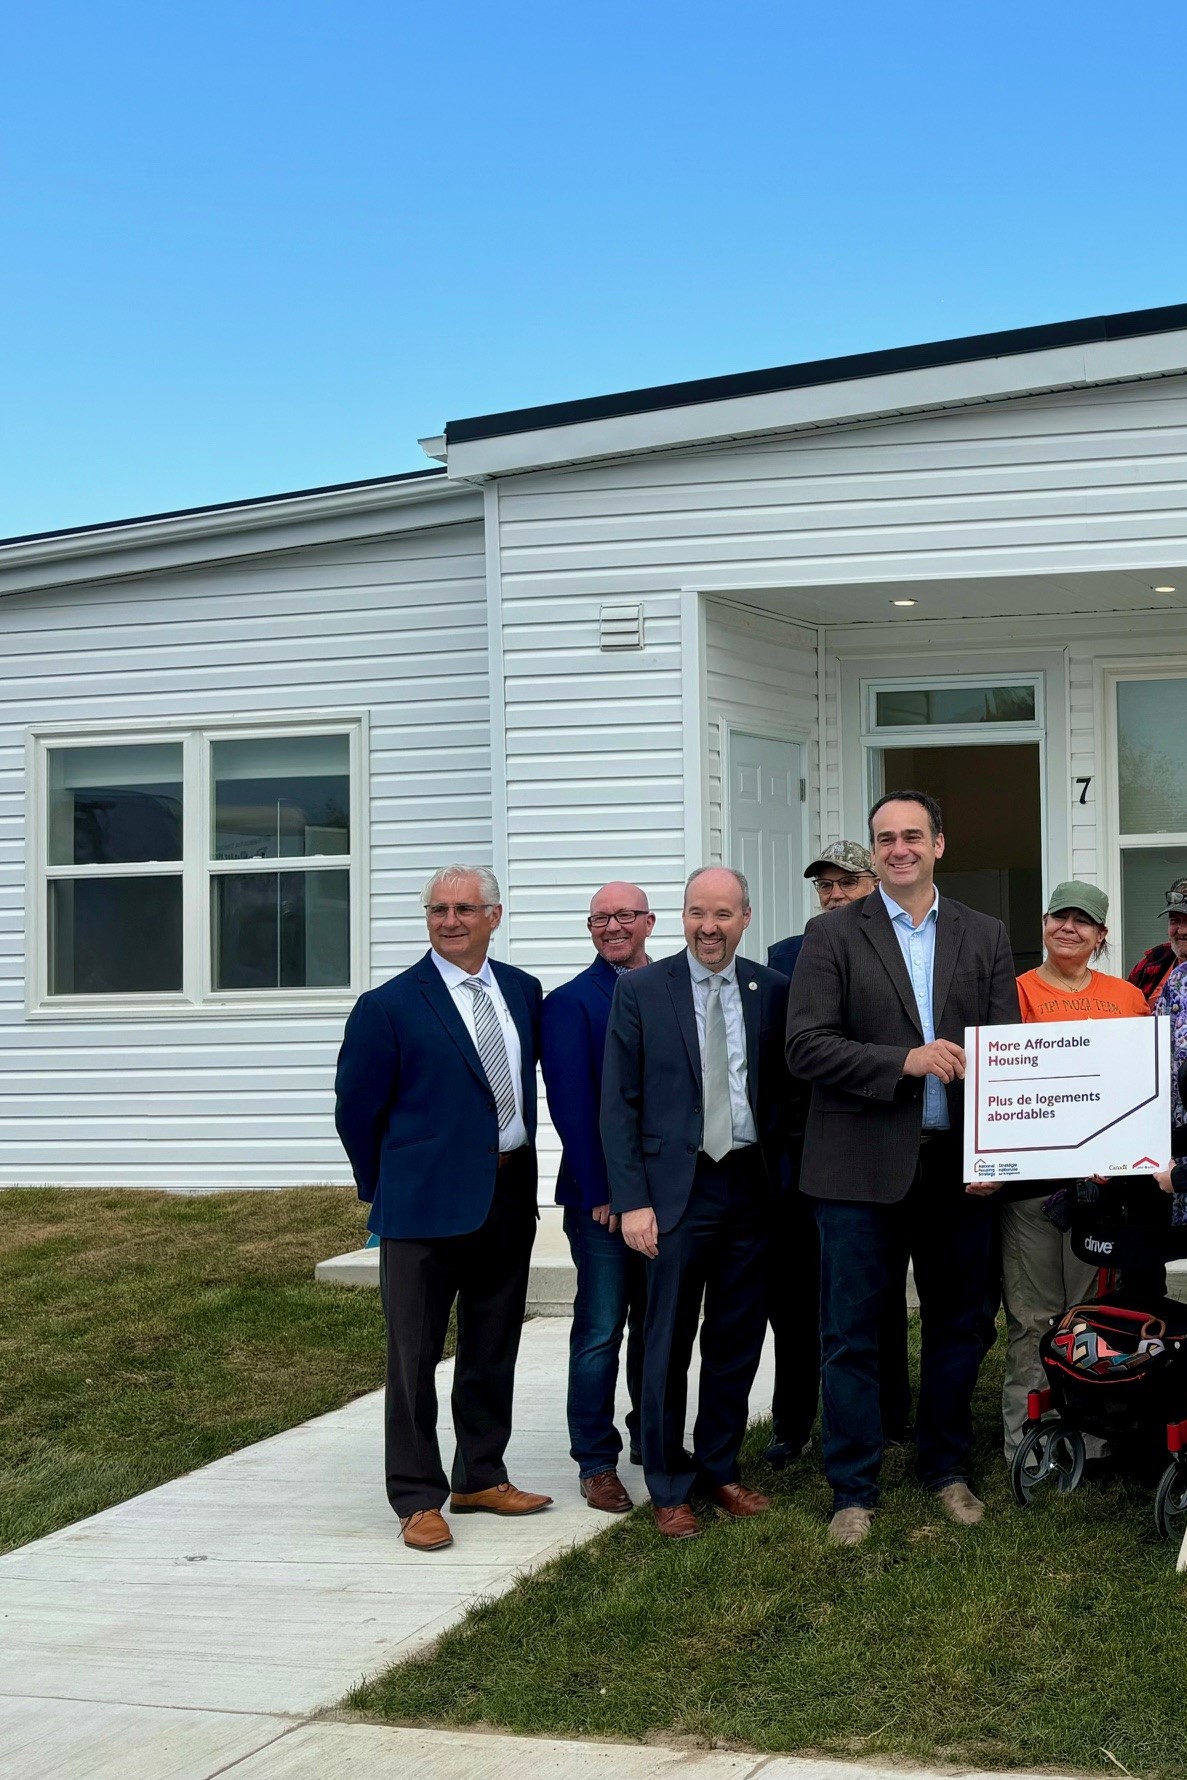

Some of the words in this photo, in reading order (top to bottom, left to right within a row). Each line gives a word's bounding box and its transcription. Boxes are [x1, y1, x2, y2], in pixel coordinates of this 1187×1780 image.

[1076, 777, 1092, 804] 7
[1093, 998, 1122, 1015] TEAM
[988, 1040, 1021, 1052] More
[1024, 1036, 1091, 1050] Affordable
[988, 1054, 1039, 1068] Housing
[988, 1096, 1013, 1107] Plus
[1017, 1094, 1032, 1105] de
[1036, 1092, 1101, 1106] logements
[987, 1108, 1056, 1122] abordables
[1085, 1236, 1113, 1254] drive
